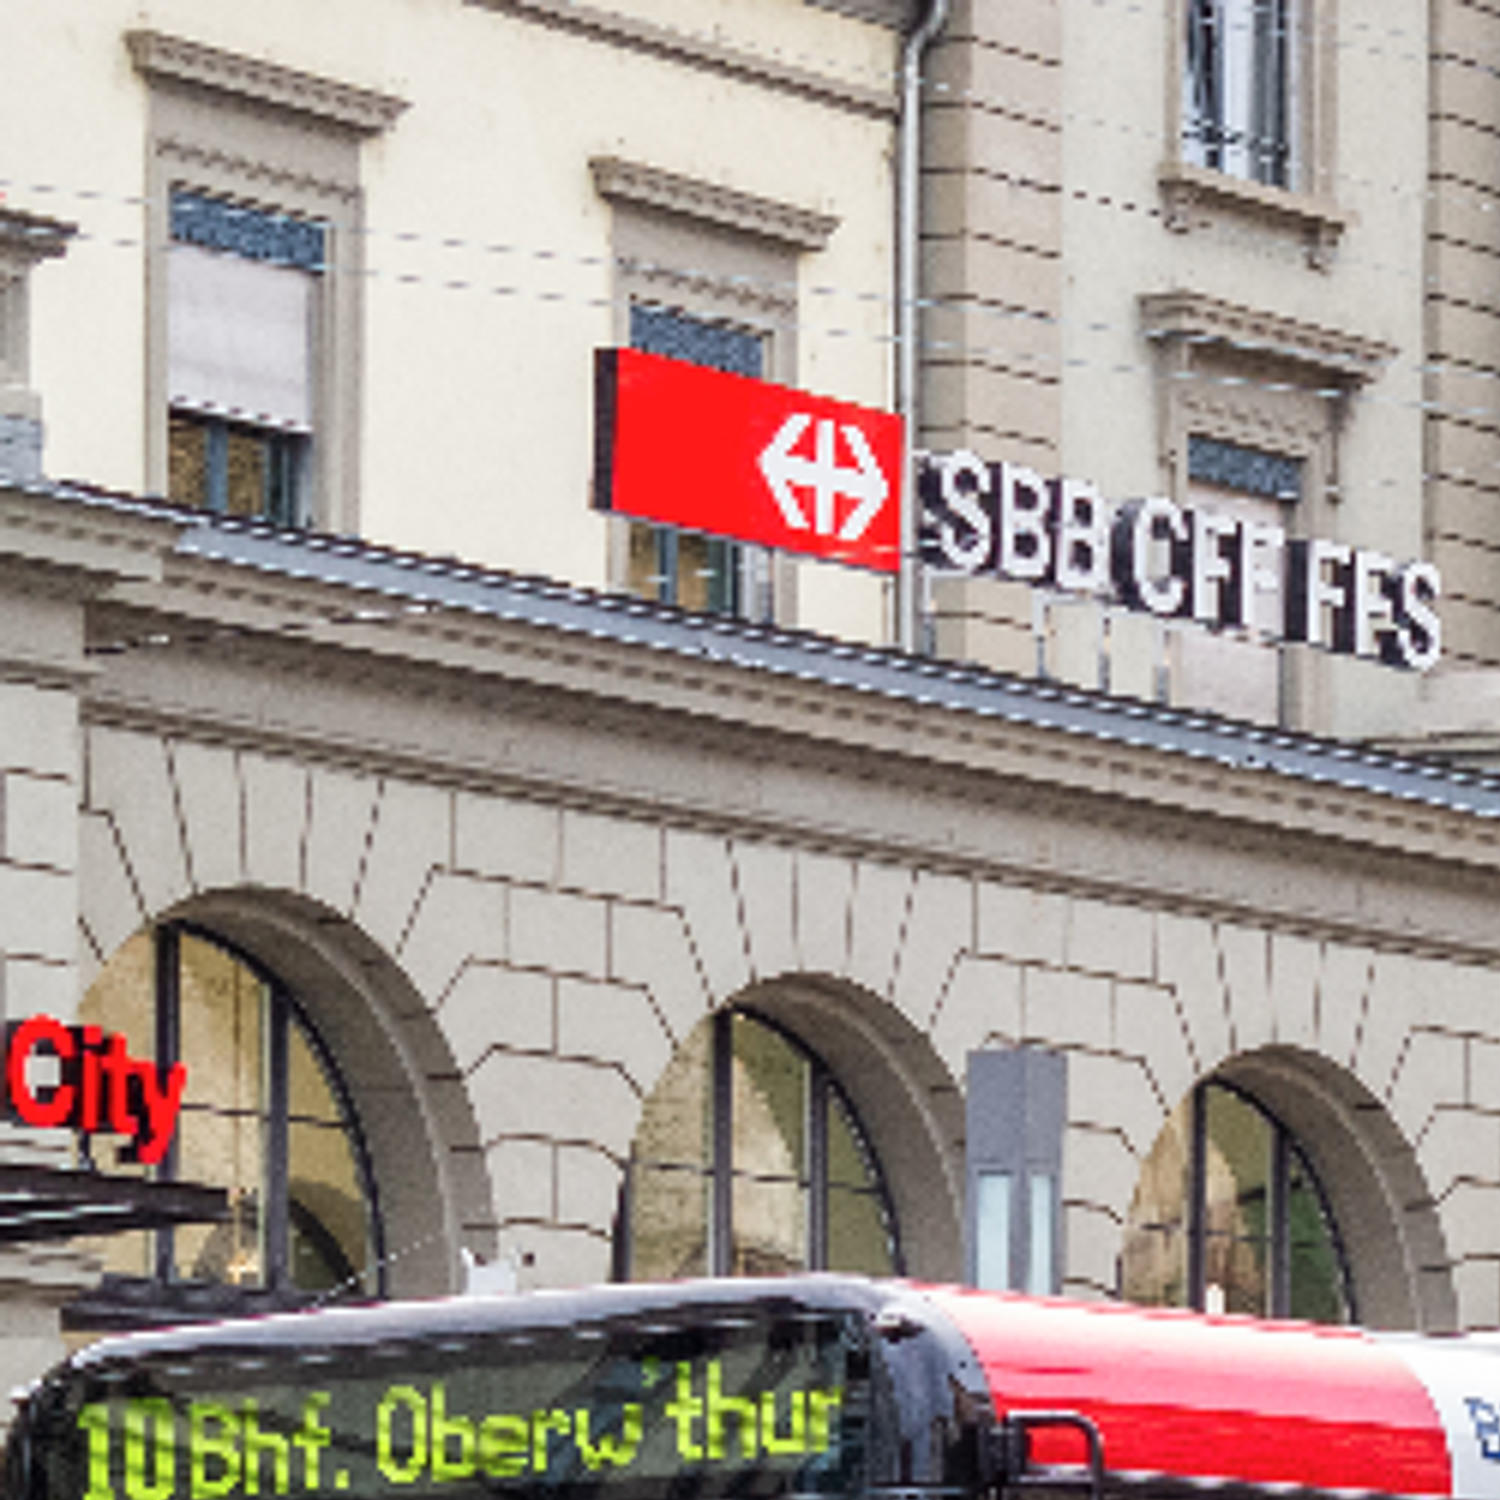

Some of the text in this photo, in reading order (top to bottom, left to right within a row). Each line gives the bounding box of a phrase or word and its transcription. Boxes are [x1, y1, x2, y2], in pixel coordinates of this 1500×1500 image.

[920, 449, 1109, 590] SBB
[1304, 538, 1441, 672] FFS
[8, 1013, 188, 1166] City
[189, 1390, 350, 1500] Bhf.
